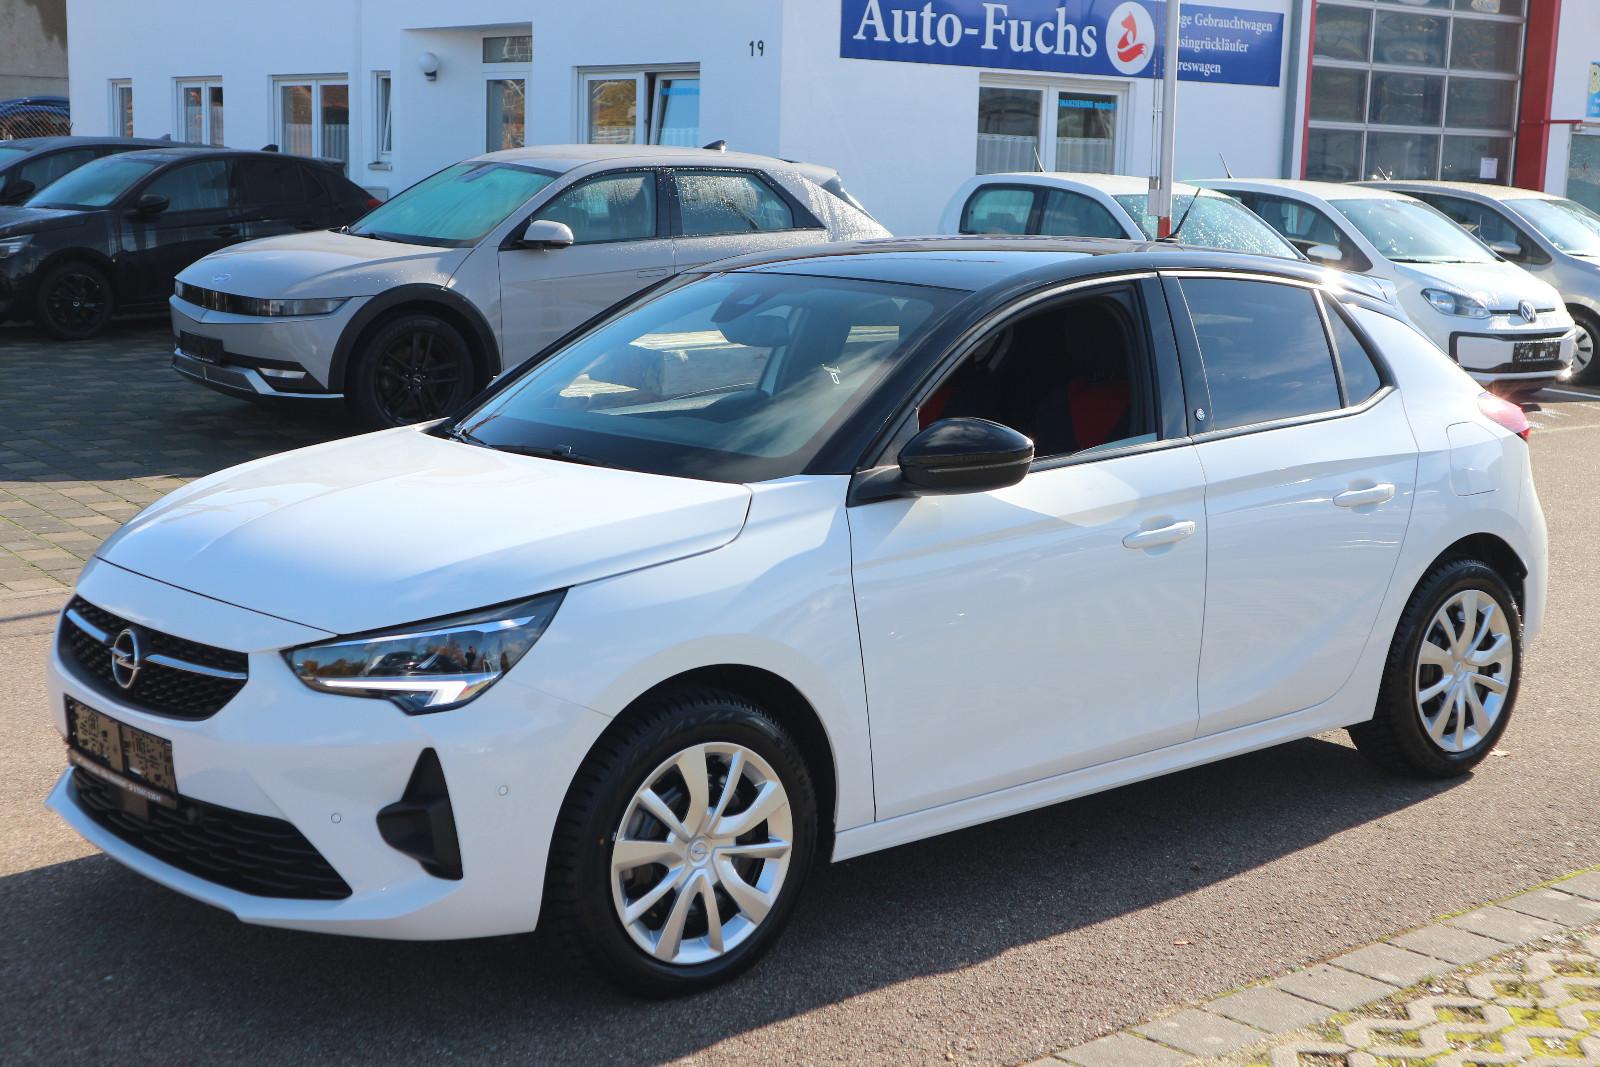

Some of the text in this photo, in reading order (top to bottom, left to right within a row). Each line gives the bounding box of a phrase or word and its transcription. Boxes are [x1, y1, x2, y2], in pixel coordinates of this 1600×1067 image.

[853, 0, 1098, 58] Auto-Fuchs
[1194, 13, 1273, 35] Gebrauchtwagen
[749, 40, 764, 57] 19
[1178, 61, 1222, 76] reswagen
